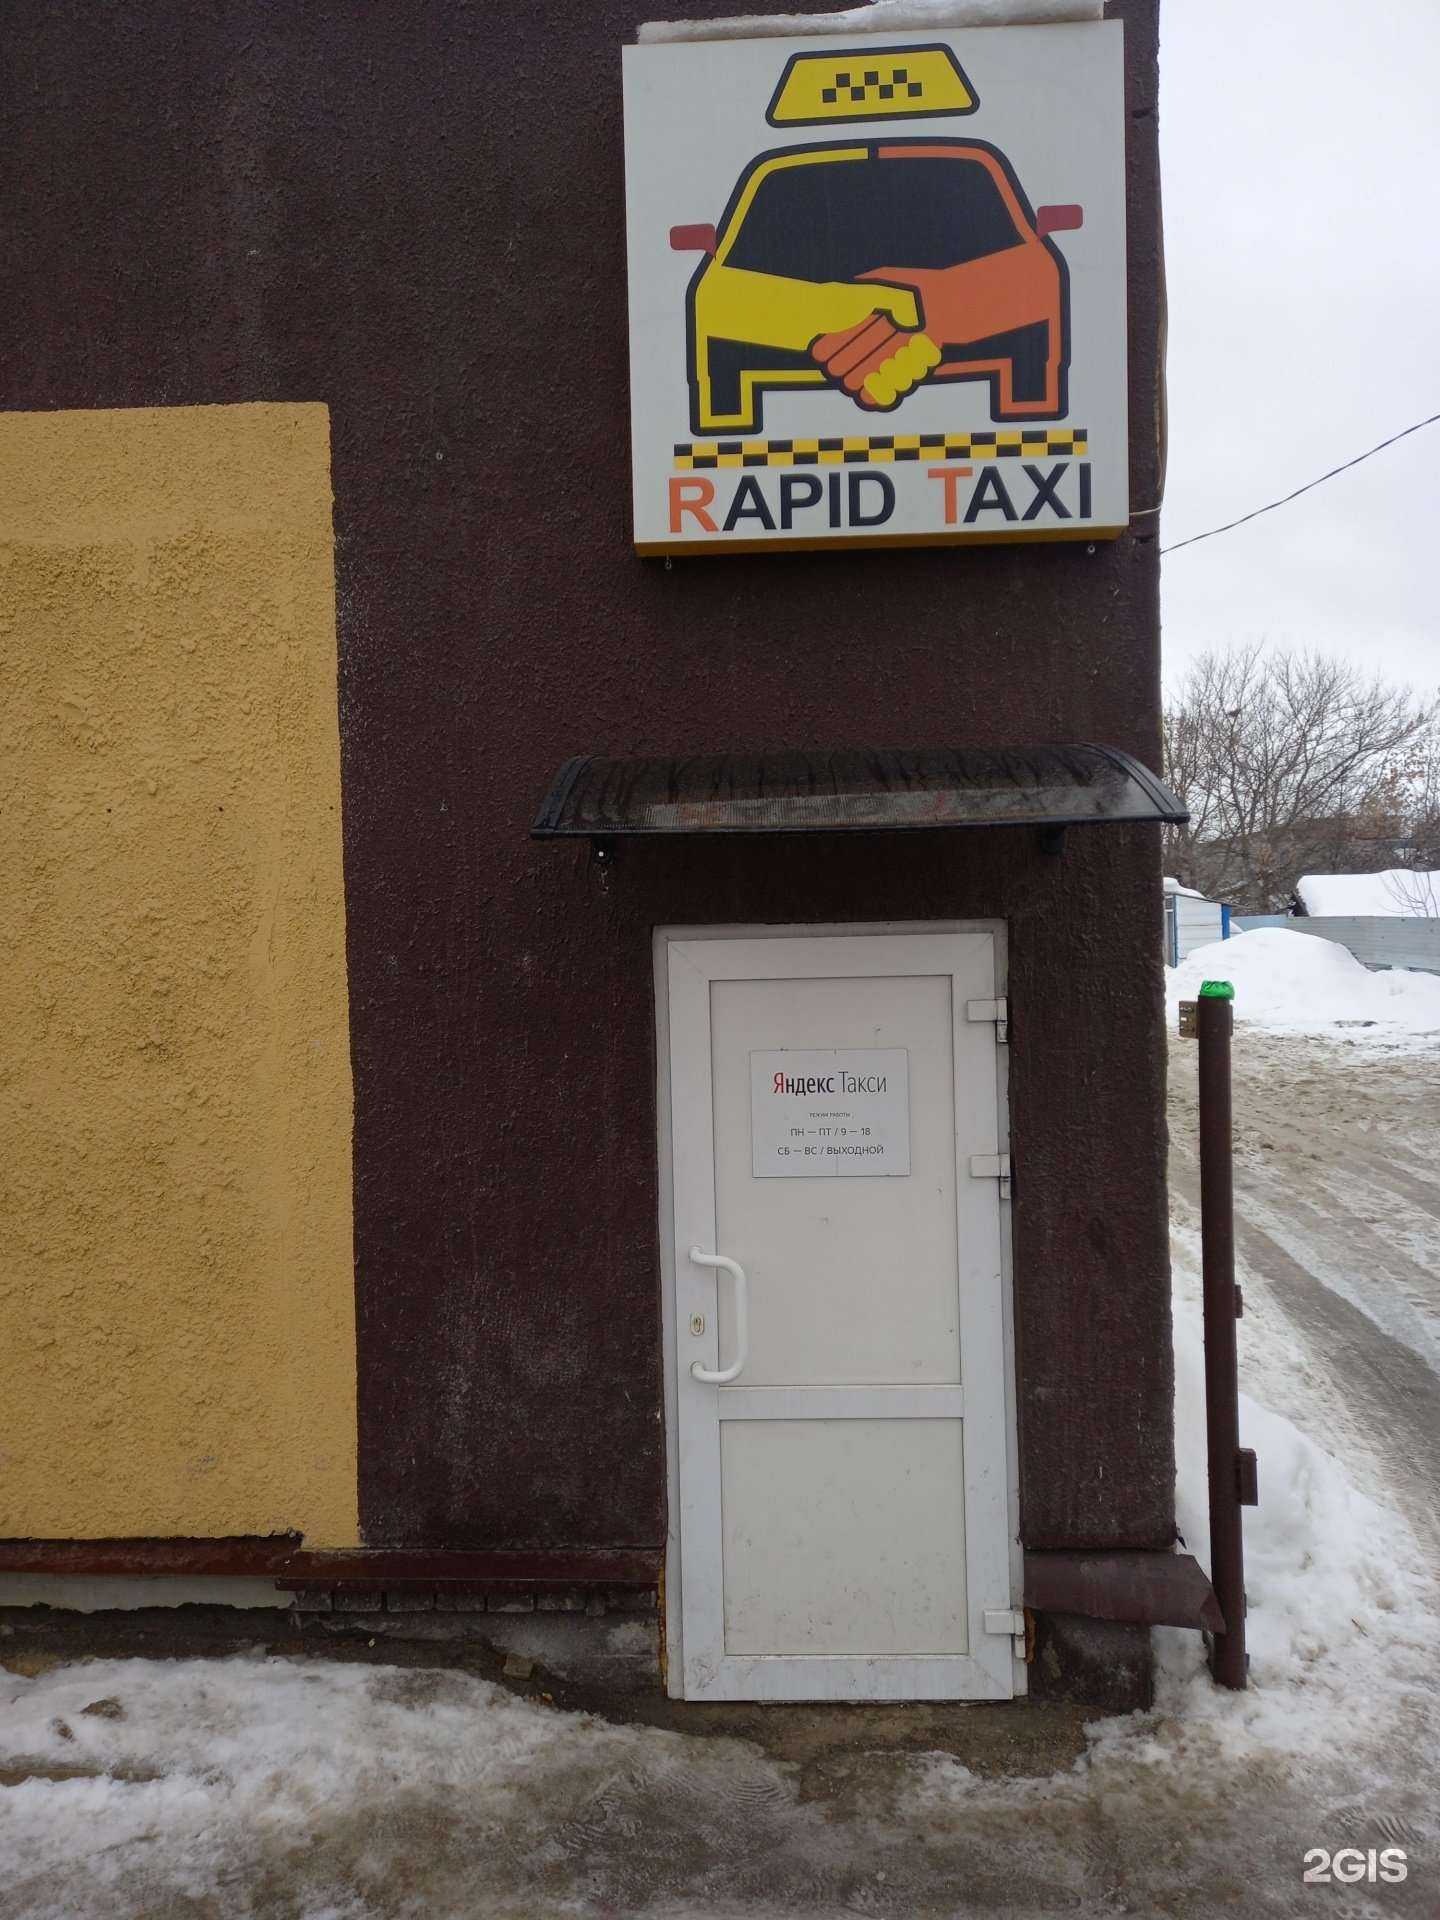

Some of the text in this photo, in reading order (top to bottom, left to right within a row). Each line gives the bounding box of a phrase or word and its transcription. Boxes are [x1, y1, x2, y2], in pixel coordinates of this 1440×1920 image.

[668, 462, 1093, 534] RAPID TAXI
[773, 1071, 887, 1096] Яндекс Такси
[790, 1128, 804, 1136] ПН
[819, 1128, 832, 1136] ПТ
[840, 1127, 847, 1136] 9
[861, 1127, 871, 1136] 18
[777, 1147, 790, 1155] СБ
[804, 1146, 817, 1155] ВС
[827, 1144, 884, 1155] ВЫХОДНОЙ
